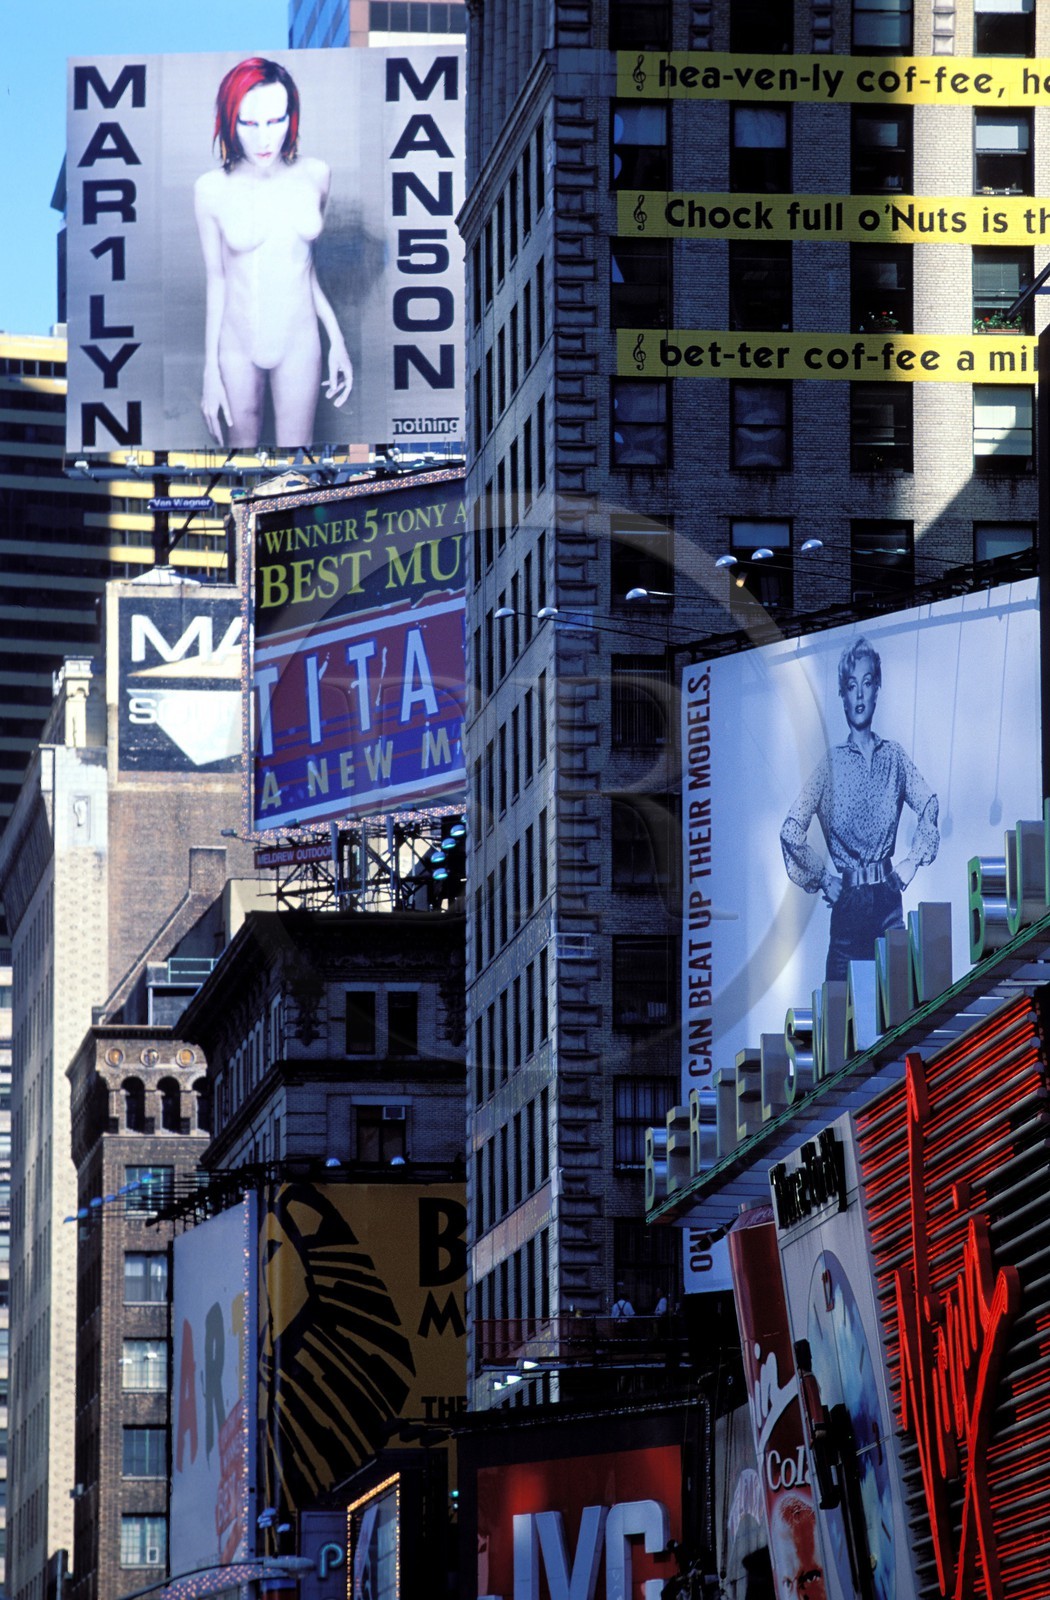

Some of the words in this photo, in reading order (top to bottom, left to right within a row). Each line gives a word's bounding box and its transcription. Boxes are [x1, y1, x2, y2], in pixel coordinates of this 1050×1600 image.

[658, 59, 843, 98] hea-ven-ly
[857, 66, 1006, 98] cof-fee,
[665, 199, 773, 229] Chock
[787, 202, 843, 231] full
[859, 203, 967, 233] o'Nuts
[982, 206, 1008, 233] is
[73, 64, 147, 447] MAR1LYN
[660, 339, 790, 368] bet-ter
[804, 342, 940, 370] cof-fee
[957, 350, 975, 370] a
[393, 417, 459, 435] nothing
[153, 499, 172, 507] Van
[173, 499, 210, 509] Wagner
[265, 519, 358, 554] WINNER
[363, 508, 378, 543] 5
[382, 503, 448, 536] TONY
[259, 550, 372, 609] BEST
[385, 535, 464, 589] MU
[687, 666, 712, 791] MODELS.
[261, 771, 282, 810] A
[307, 740, 394, 798] NEW
[421, 722, 467, 769] M
[257, 850, 295, 866] MELDREW
[688, 798, 712, 884] THEIR
[688, 890, 712, 931] UP
[688, 939, 713, 1009] BEAT
[645, 902, 953, 1212] BERTELSMANN
[688, 1017, 713, 1078] CAN
